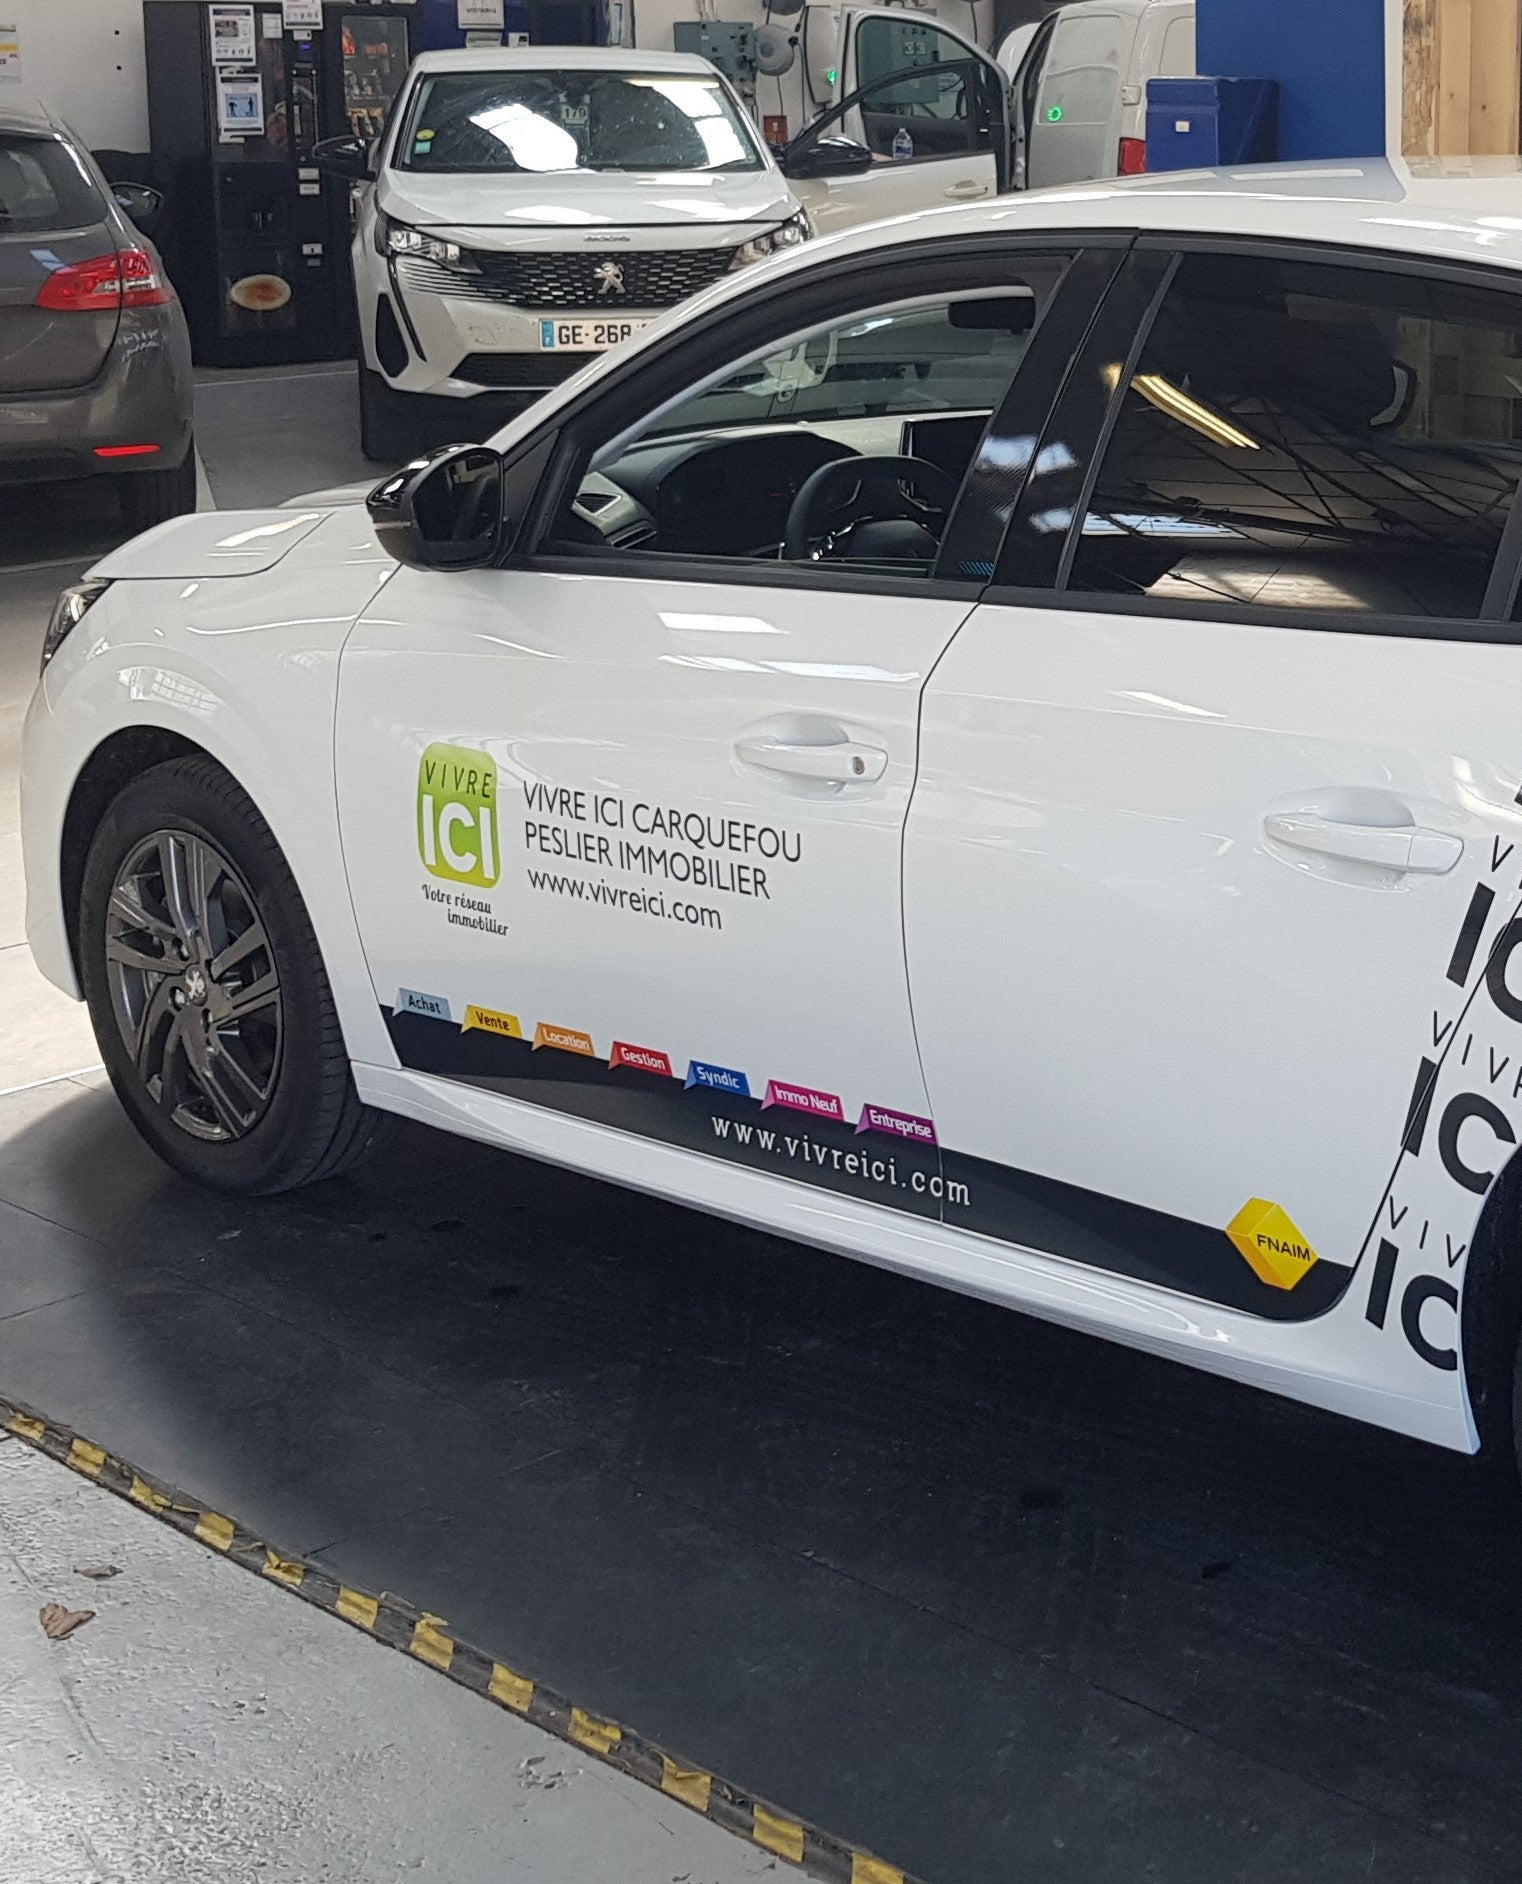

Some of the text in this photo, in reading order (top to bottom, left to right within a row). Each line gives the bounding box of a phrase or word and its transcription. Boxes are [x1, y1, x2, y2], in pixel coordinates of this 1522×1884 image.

[426, 760, 492, 798] VIVRE
[523, 780, 801, 862] VIVRE ICI CARQUEFOU
[422, 794, 495, 879] ICI
[525, 821, 771, 900] PESLIER IMMOBILIER
[421, 884, 491, 914] Votre réseau
[527, 868, 722, 930] www.vivreici.com
[447, 908, 508, 936] immobilier
[408, 994, 442, 1015] Achat
[476, 1011, 510, 1031] Vente
[542, 1027, 590, 1051] Location
[620, 1046, 666, 1070] Gestion
[696, 1066, 741, 1089] Syndic
[775, 1086, 838, 1114] Immo Neuf
[869, 1109, 933, 1138] Entreprise
[1400, 1056, 1517, 1196] IC
[711, 1116, 971, 1206] www.vivreici.com
[1390, 1195, 1466, 1269] VIV
[1257, 1234, 1310, 1262] FNAIM
[1365, 1237, 1458, 1371] IC
